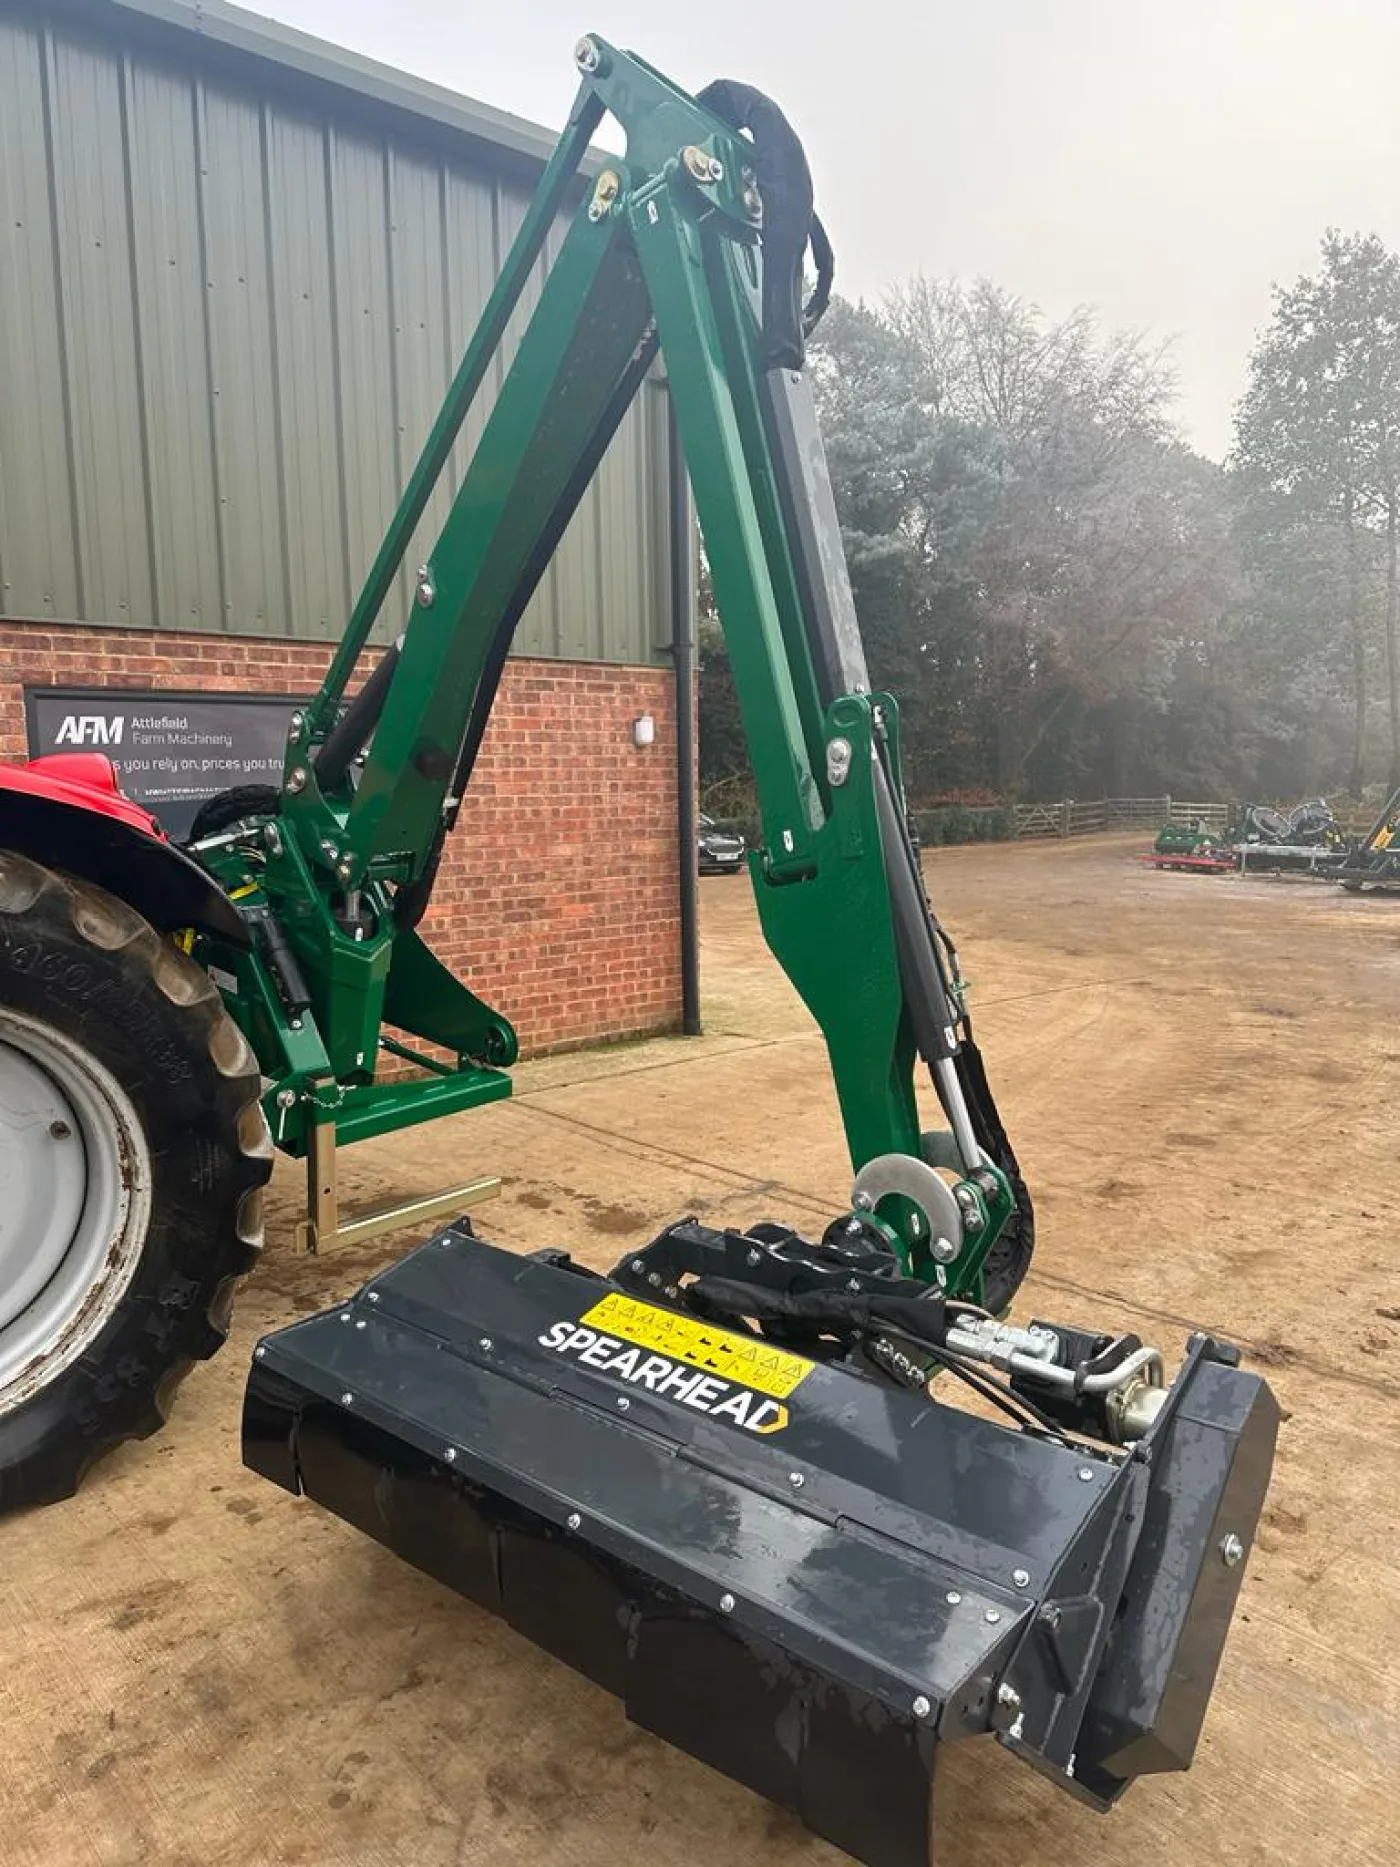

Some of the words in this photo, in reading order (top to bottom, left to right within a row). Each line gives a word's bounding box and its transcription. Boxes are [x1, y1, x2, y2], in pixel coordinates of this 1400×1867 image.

[54, 716, 124, 745] AFM
[131, 716, 188, 730] Attlefield
[132, 732, 165, 745] Farm
[167, 732, 232, 748] Machinery
[123, 759, 150, 774] you
[152, 757, 178, 773] rely
[243, 759, 267, 772] you
[267, 757, 285, 771] tru
[538, 1321, 789, 1434] SPEARHEAD
